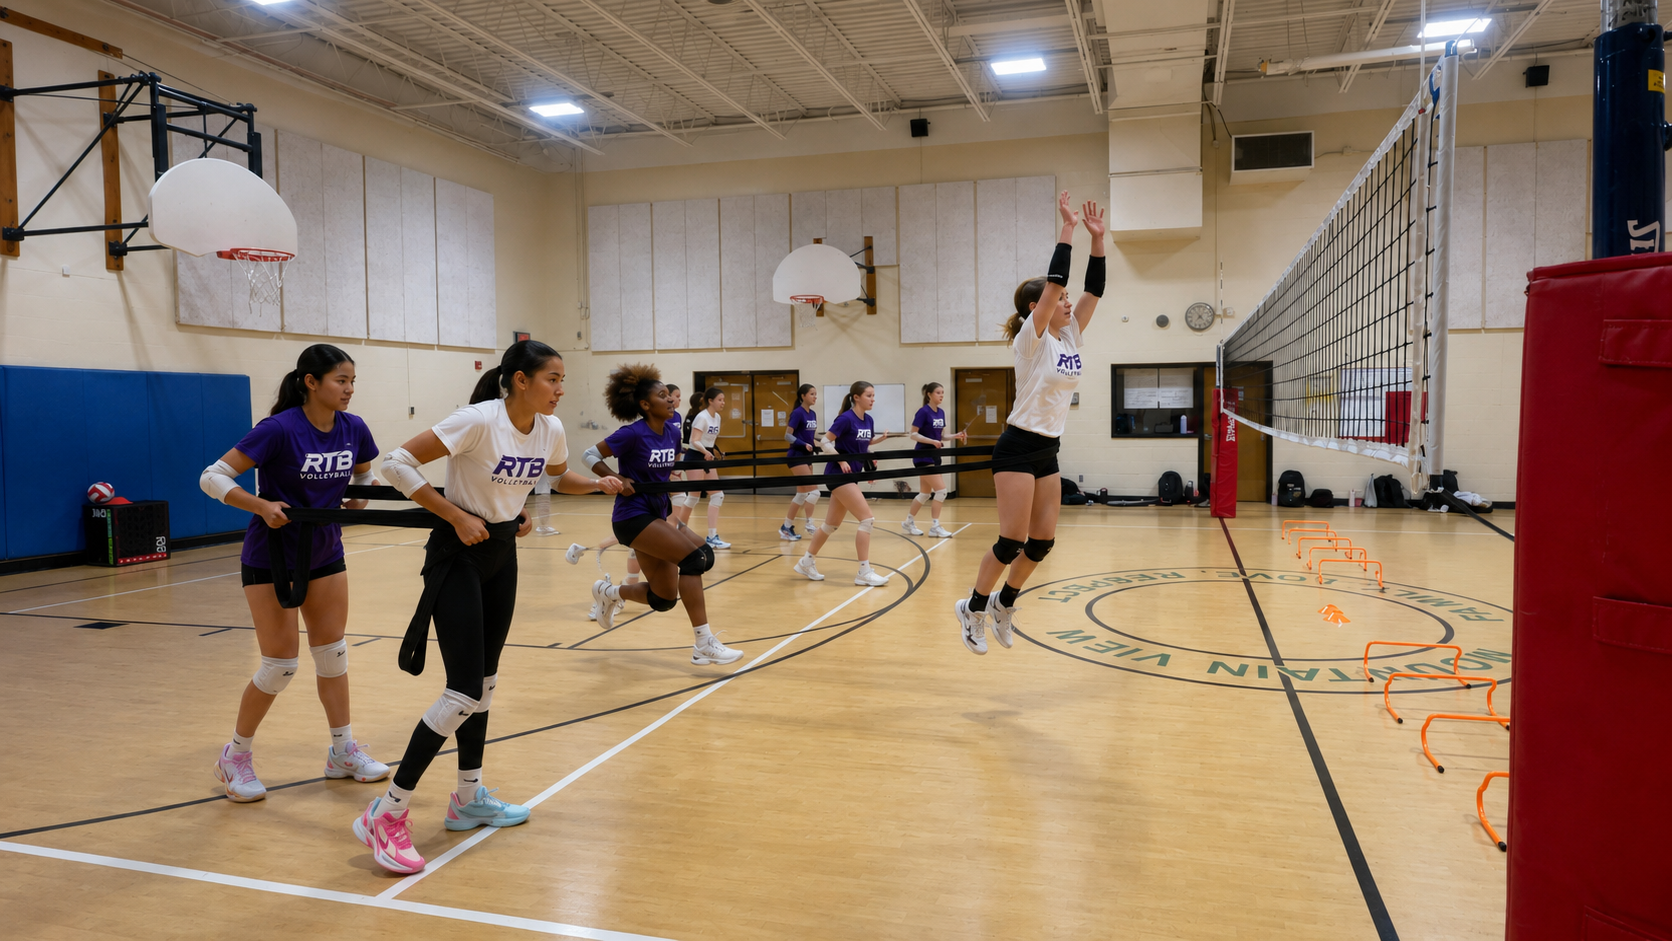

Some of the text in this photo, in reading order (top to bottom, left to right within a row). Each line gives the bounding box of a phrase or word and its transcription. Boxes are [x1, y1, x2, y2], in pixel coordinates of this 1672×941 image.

[1057, 354, 1082, 370] RTB
[300, 450, 354, 473] RTB
[492, 454, 546, 478] RTB
[649, 448, 676, 463] RTB
[1046, 629, 1172, 667] VIEW
